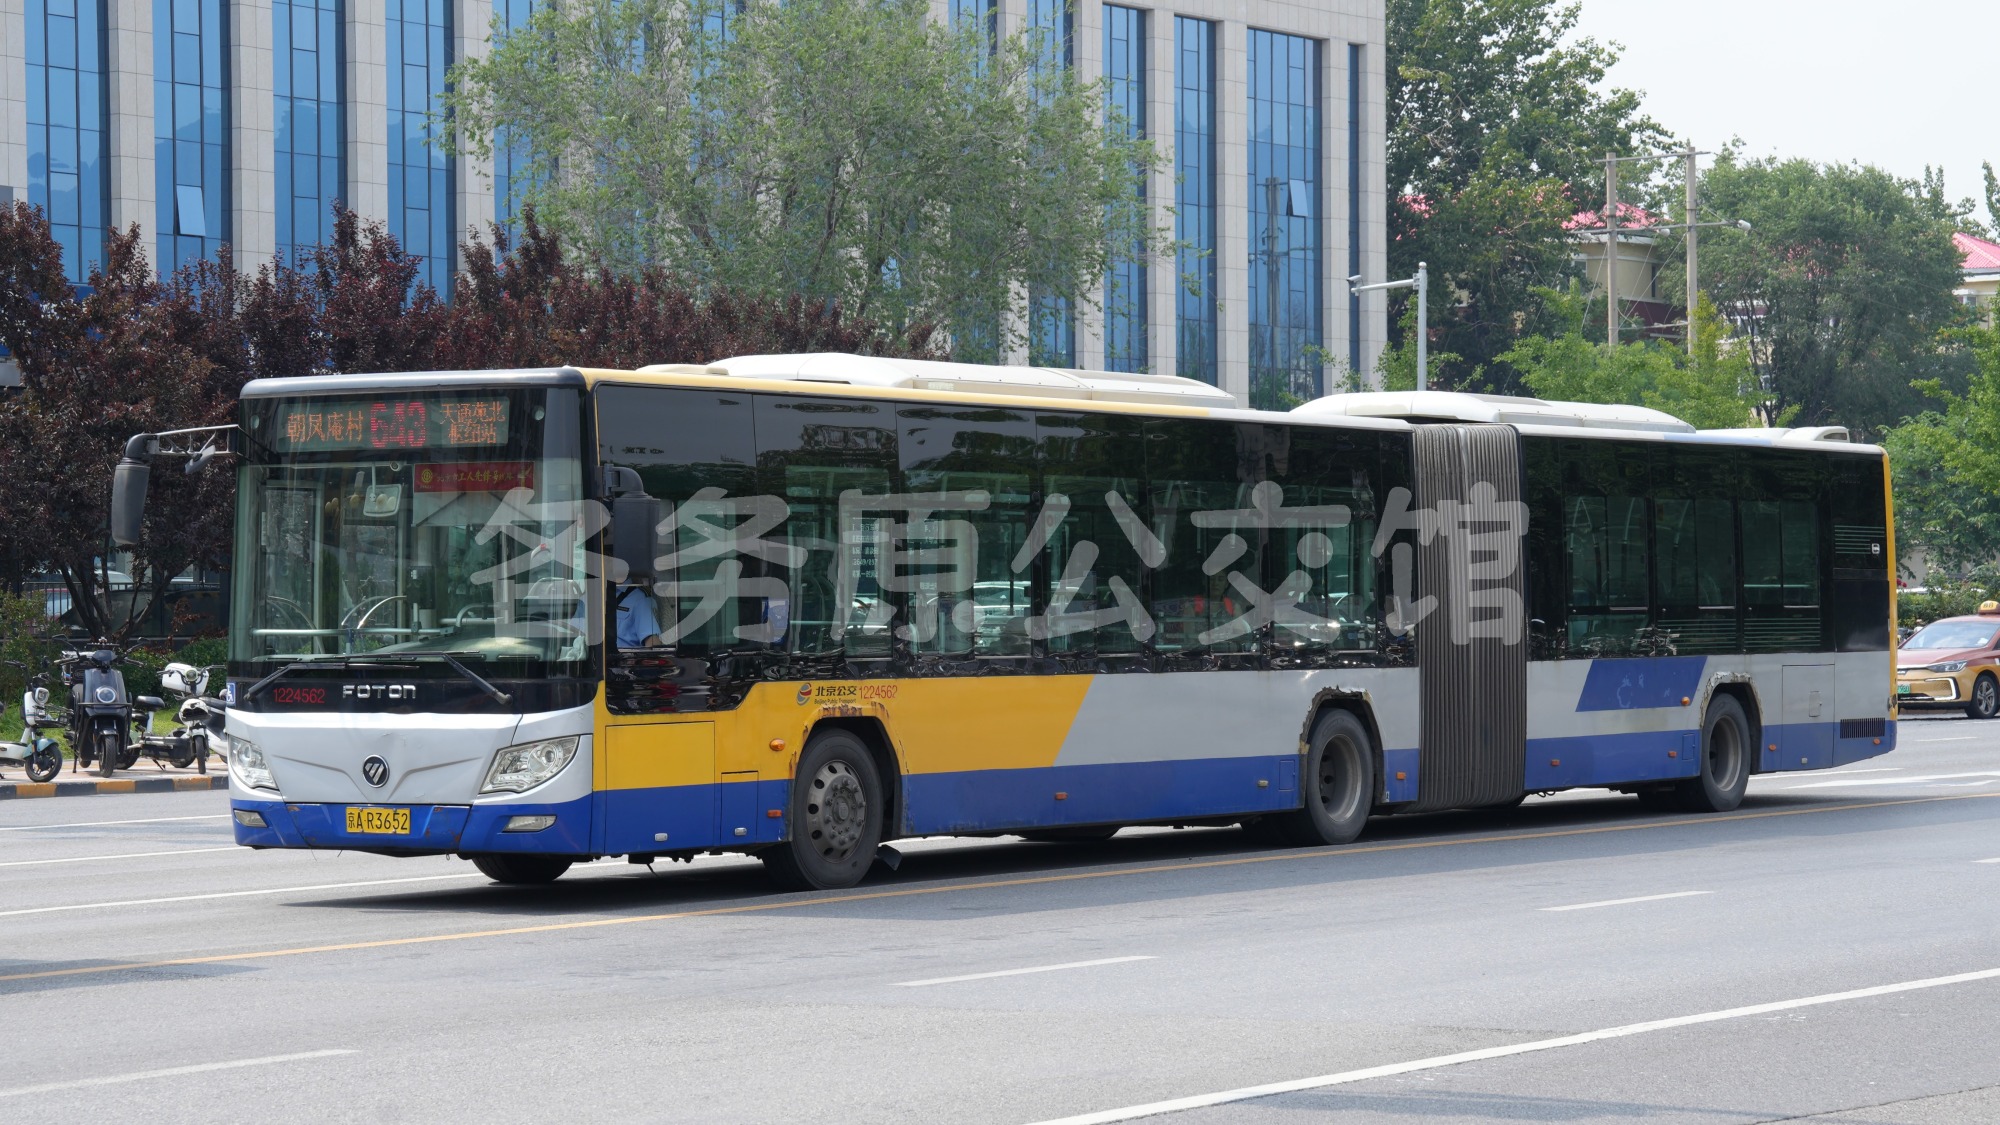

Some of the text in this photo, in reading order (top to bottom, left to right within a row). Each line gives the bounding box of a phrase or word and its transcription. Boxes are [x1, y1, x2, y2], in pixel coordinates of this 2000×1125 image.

[370, 402, 426, 447] 643
[274, 687, 326, 704] 1224562
[343, 684, 417, 700] FOTON
[815, 685, 898, 699] 北京公交 1224562
